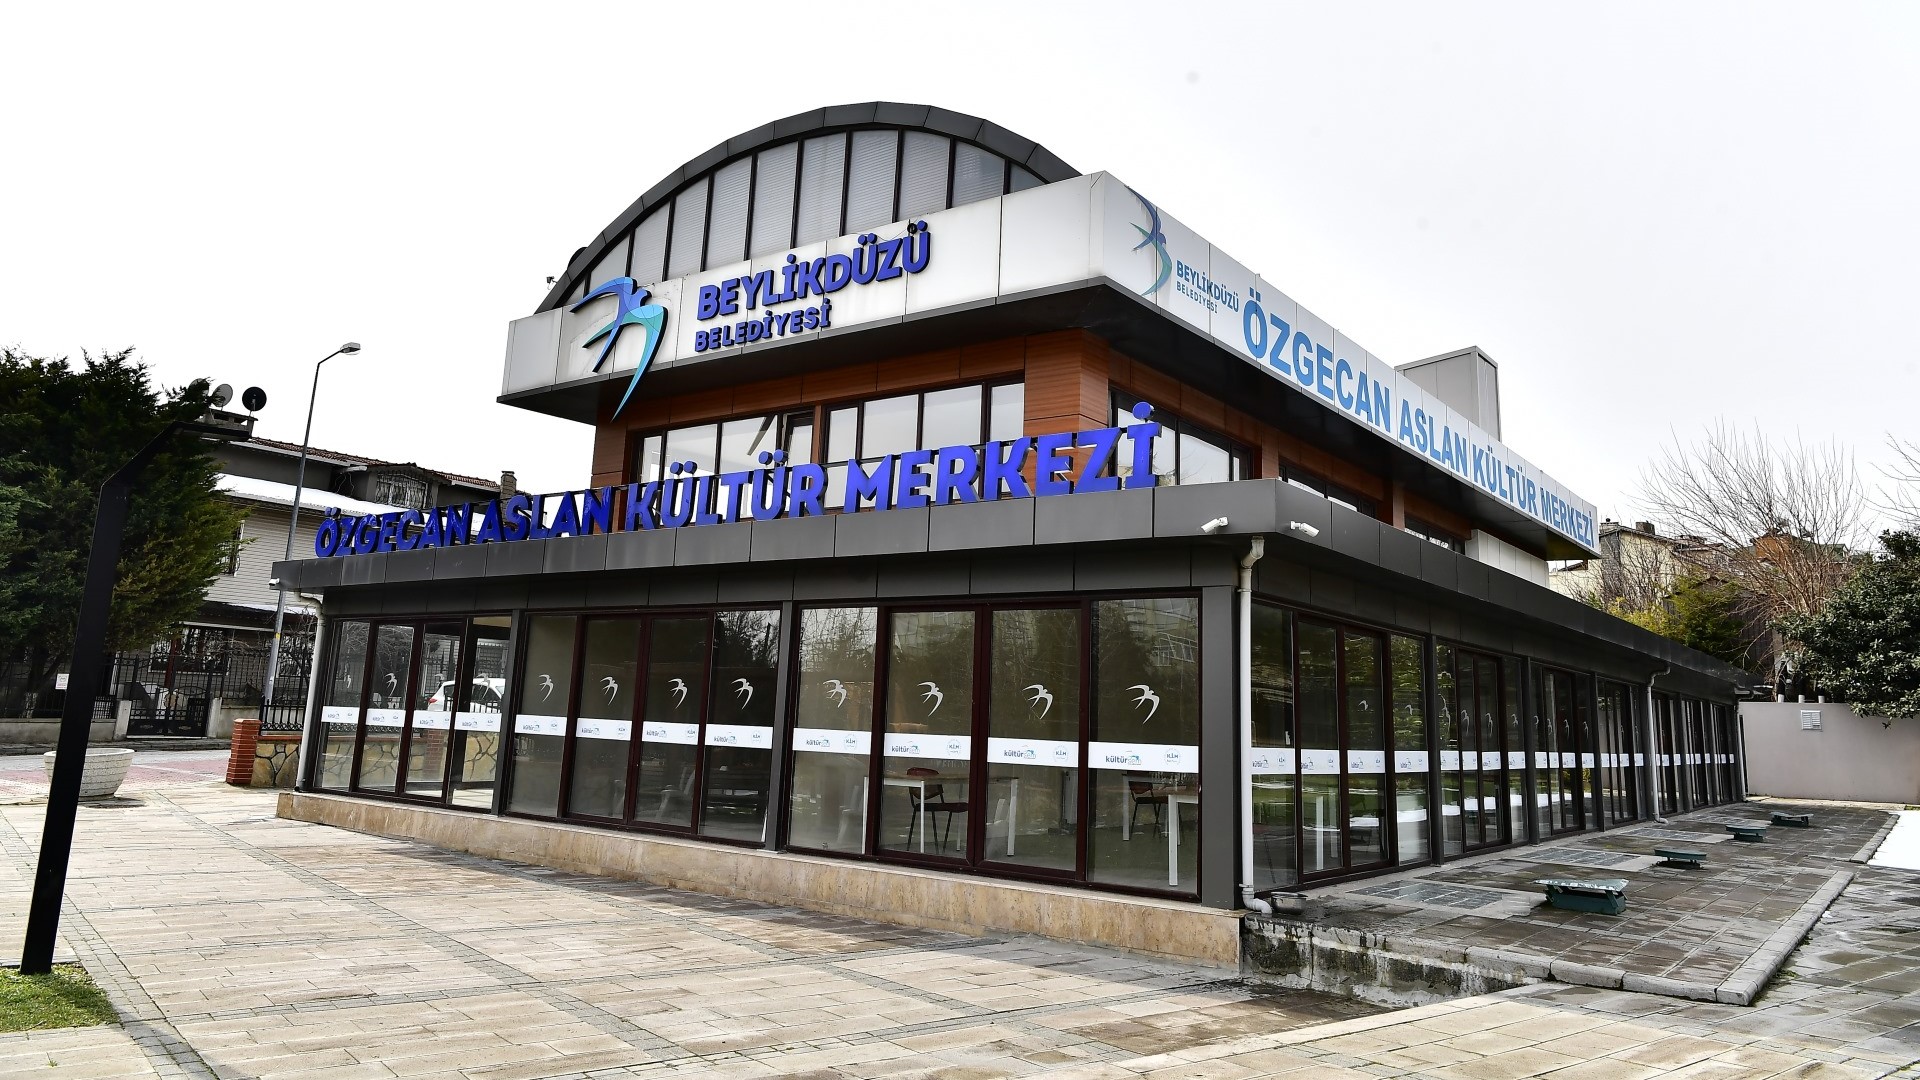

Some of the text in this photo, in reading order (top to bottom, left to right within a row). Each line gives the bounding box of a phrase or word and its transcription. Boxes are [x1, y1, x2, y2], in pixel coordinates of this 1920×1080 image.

[697, 220, 931, 321] BEYLİKDÜZÜ
[1176, 260, 1239, 312] BEYLİKDÜZÜ
[1176, 280, 1218, 314] BELEDİYESİ
[694, 298, 832, 352] BELEDİYESİ
[1243, 286, 1595, 548] ÖZGECAN ASLAN KÜLTÜR MERKEZİ
[314, 401, 1162, 558] ÖZGECAN ASLAN KÜLTÜR MERKEZİ
